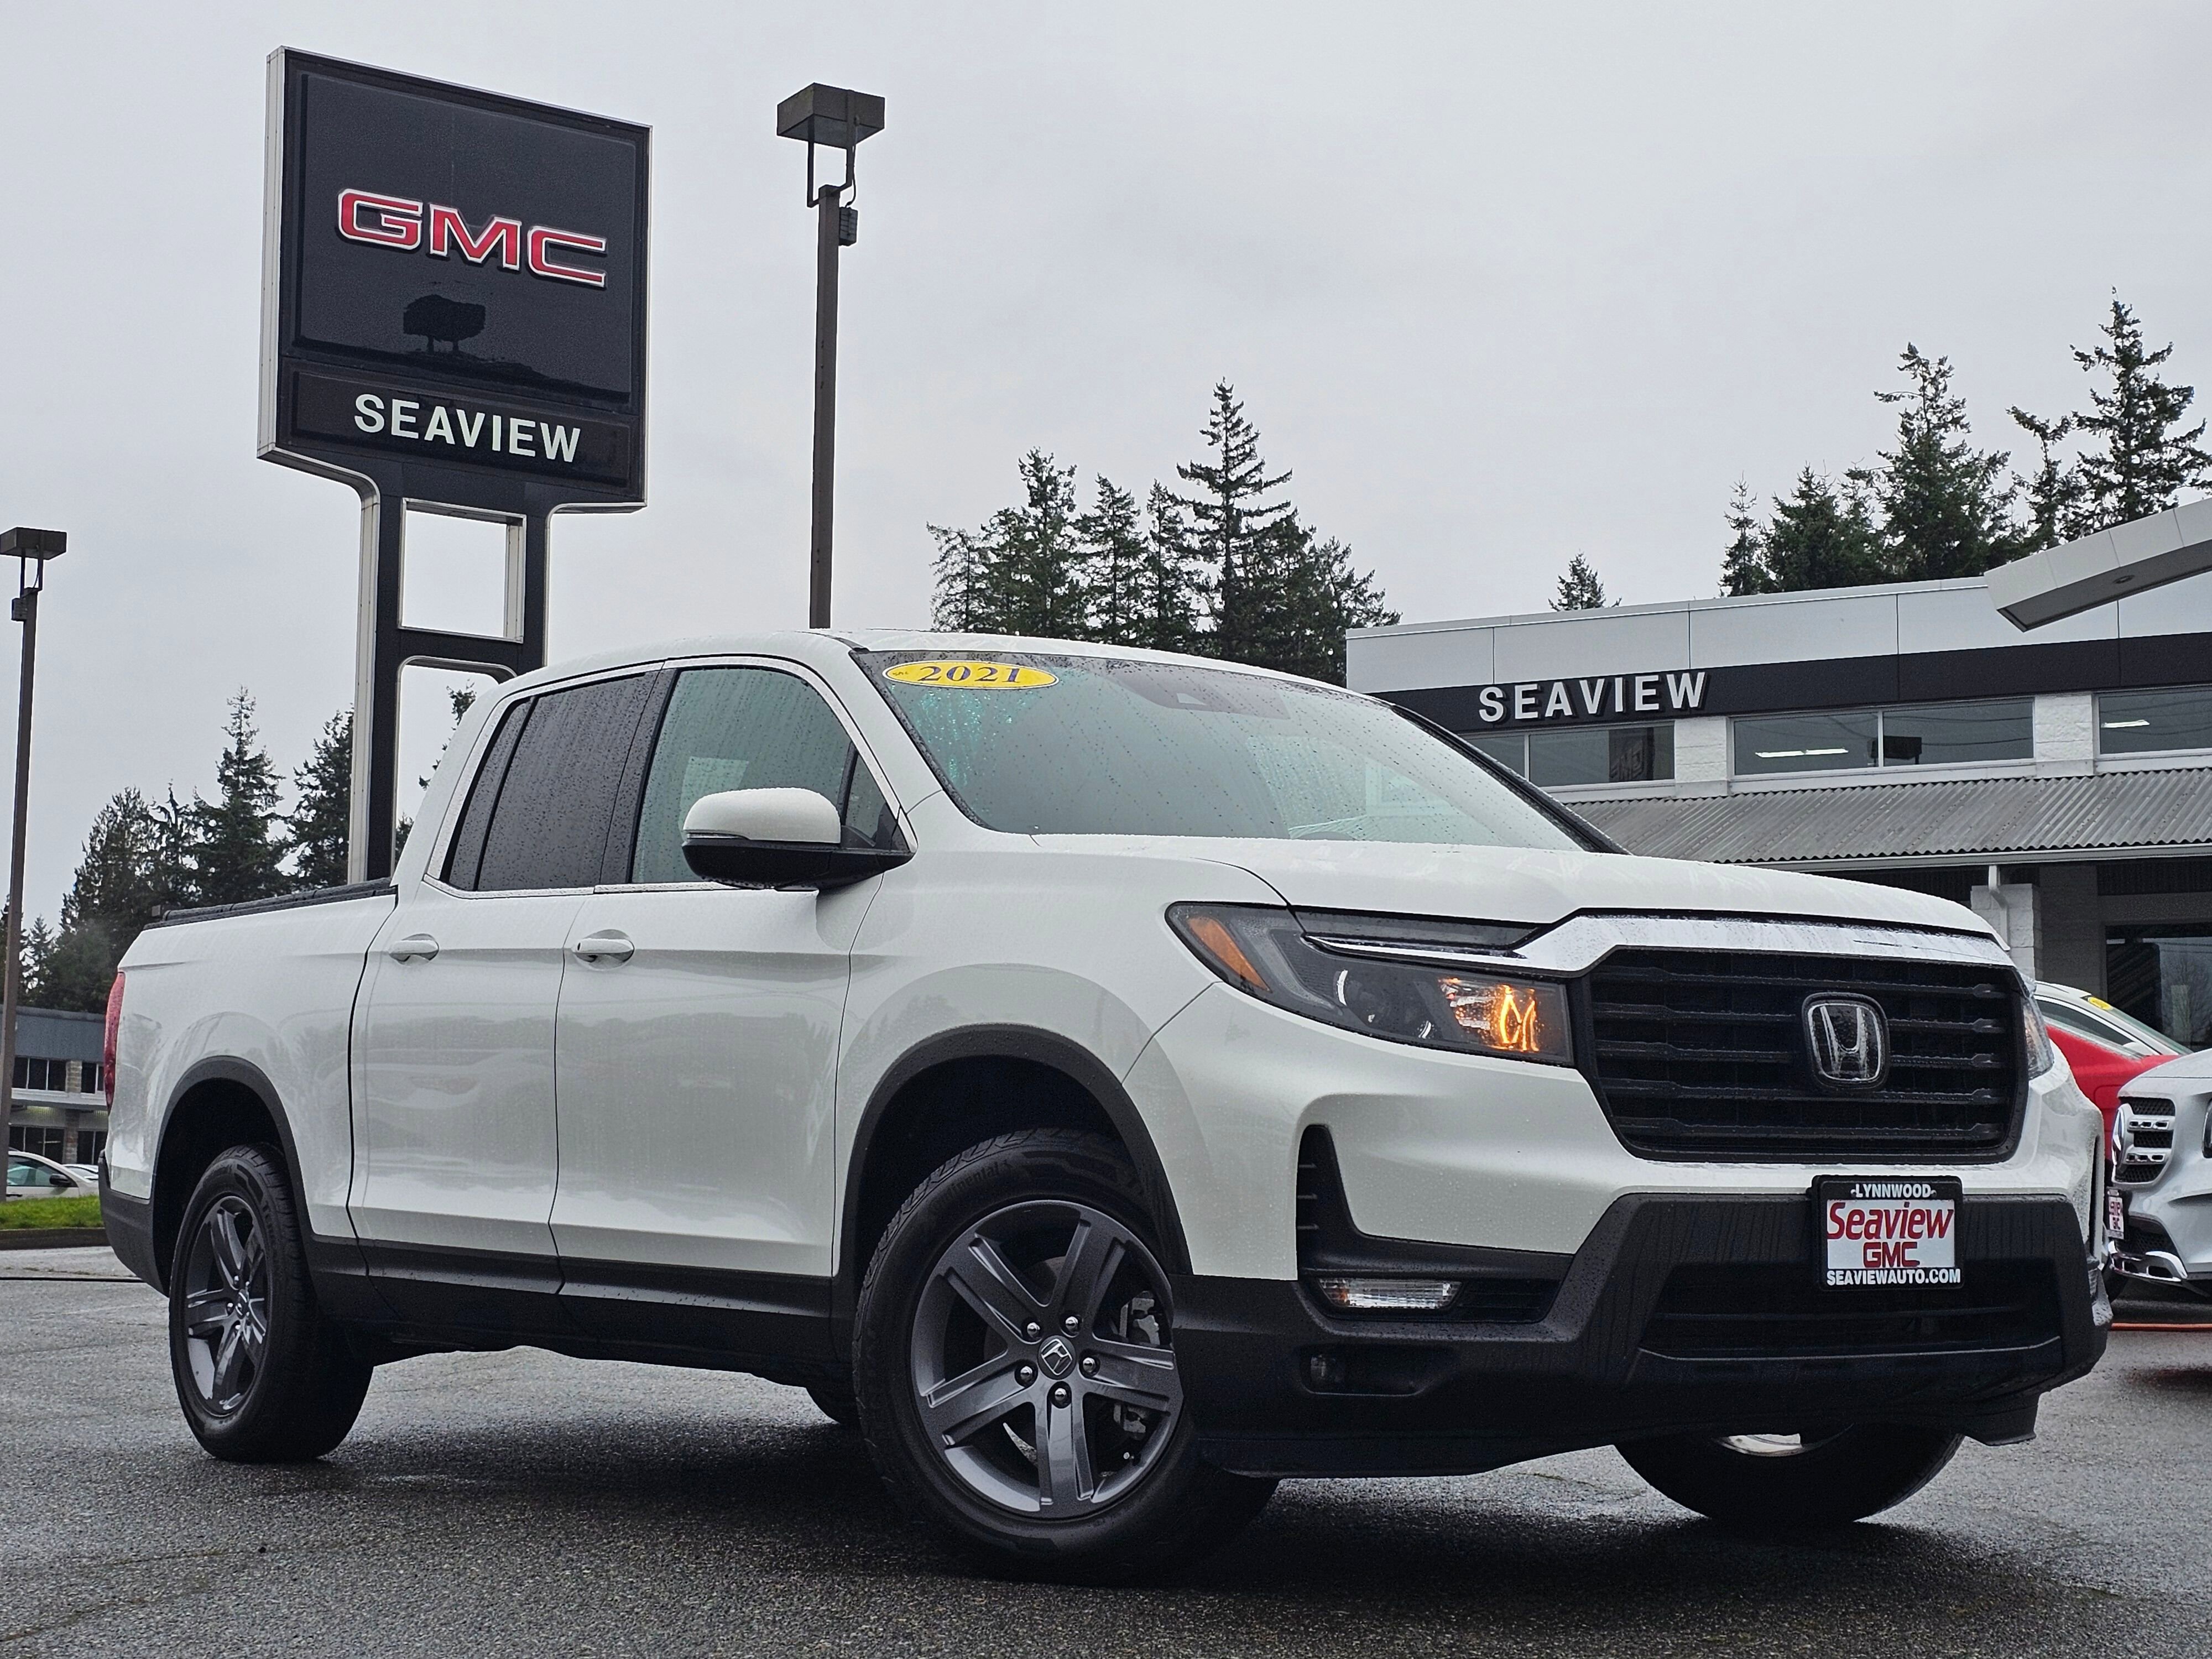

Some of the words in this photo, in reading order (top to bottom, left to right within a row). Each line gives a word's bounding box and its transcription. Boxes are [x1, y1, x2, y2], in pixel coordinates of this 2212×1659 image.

[338, 189, 607, 288] GMC
[354, 394, 581, 462] SEAVIEW
[918, 665, 1021, 684] 2021
[1479, 671, 1705, 722] SEAVIEW
[1855, 1183, 1931, 1198] LYNNWOOD
[1827, 1202, 1954, 1240] Seaview
[1863, 1241, 1920, 1267] GMC
[1827, 1268, 1961, 1286] SEAVIEWAUTO.COM
